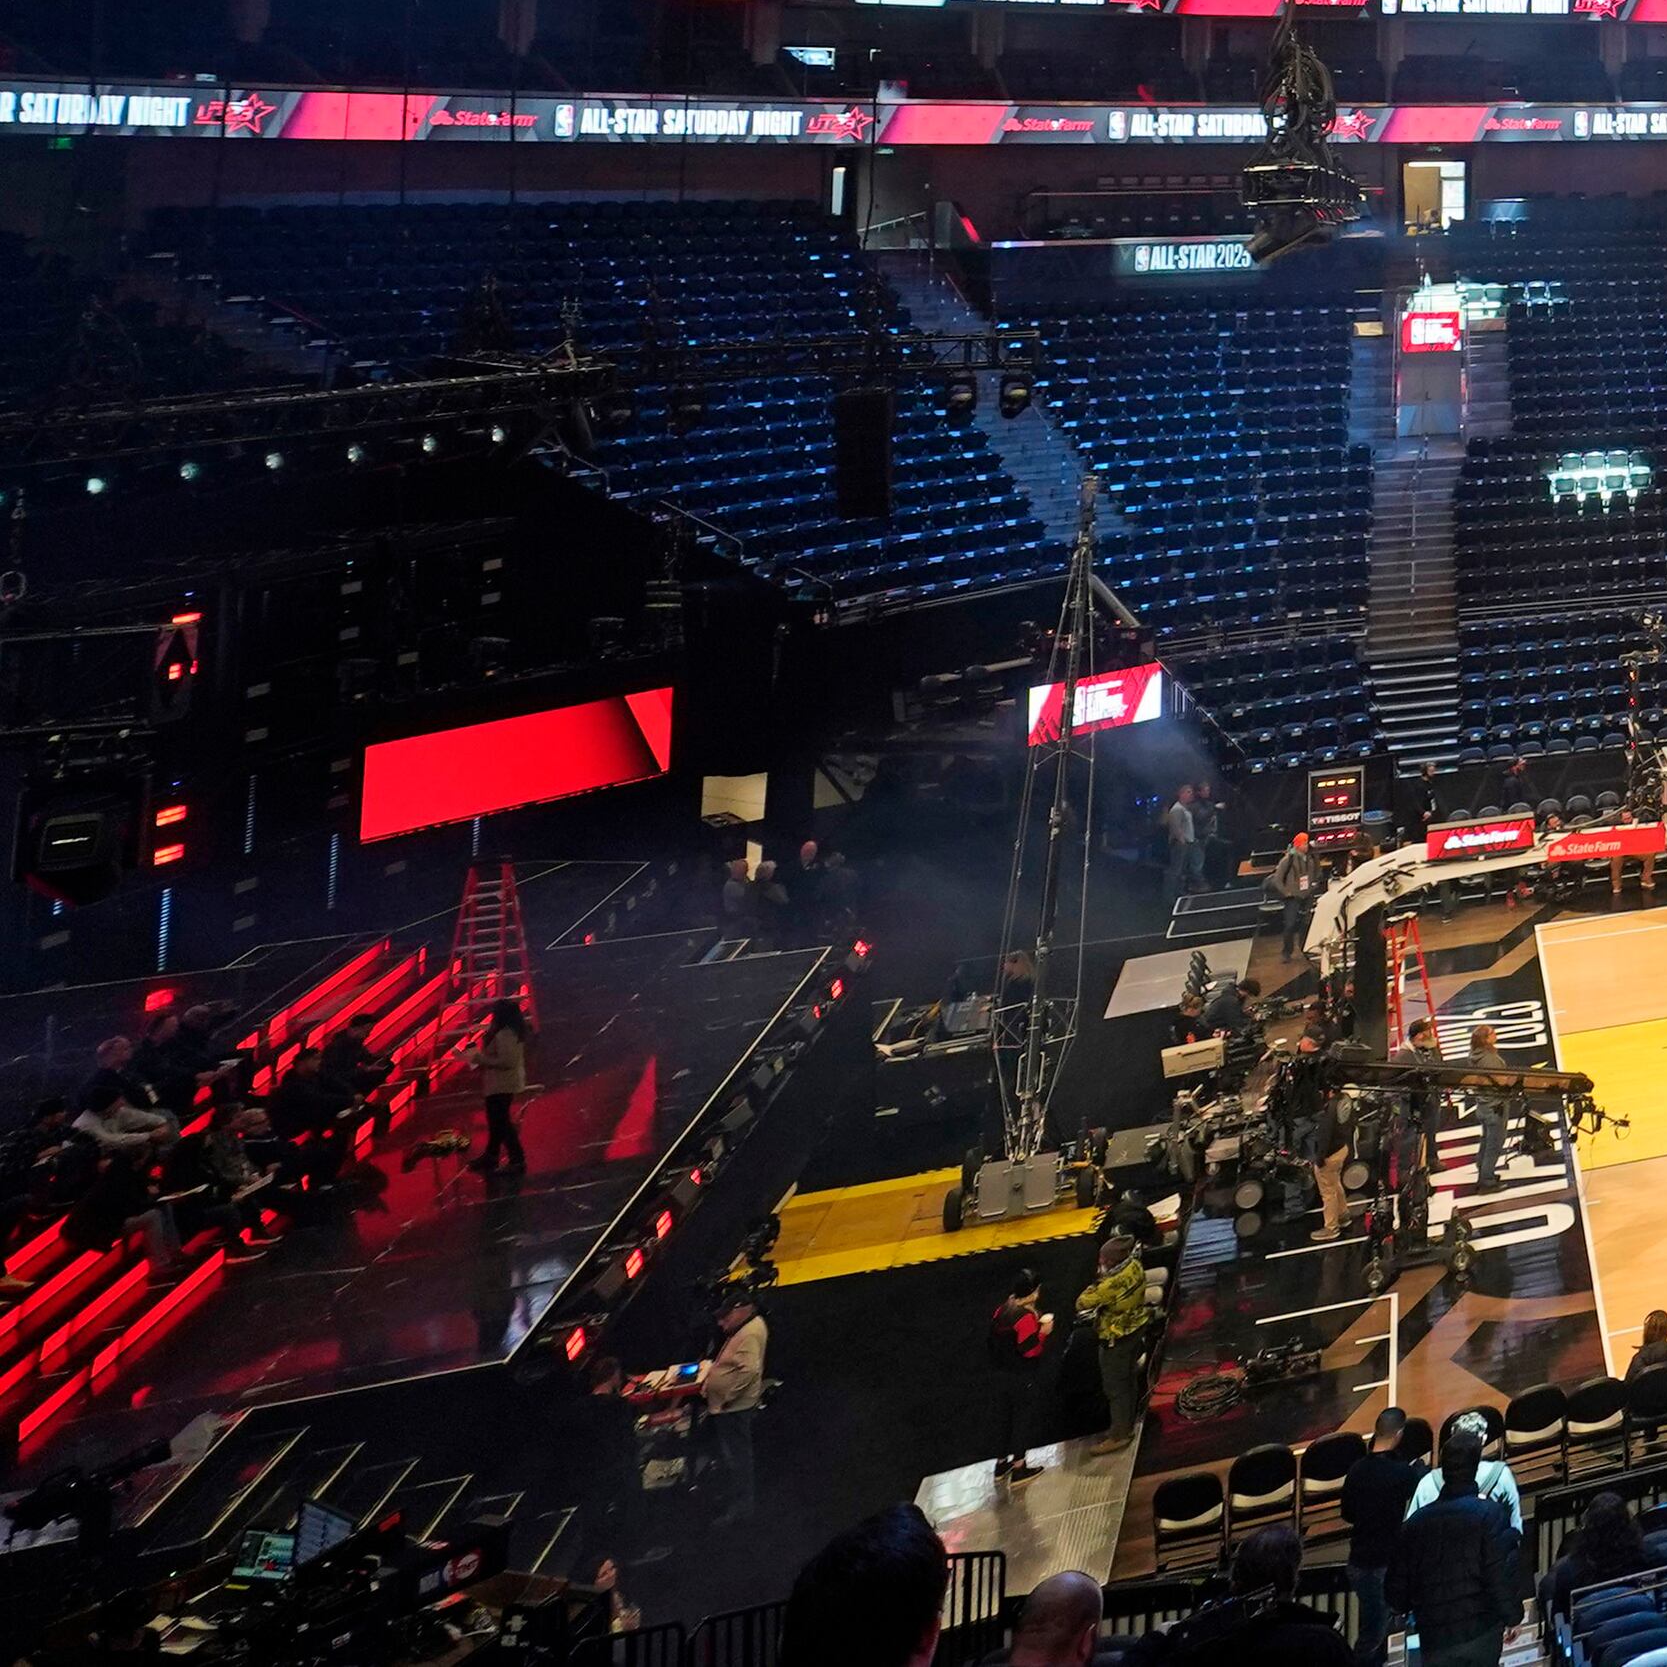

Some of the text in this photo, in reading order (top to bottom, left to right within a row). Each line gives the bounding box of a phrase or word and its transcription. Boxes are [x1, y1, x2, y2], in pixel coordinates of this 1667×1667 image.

[19, 92, 126, 125] SATURDAY
[127, 95, 191, 127] NIGHT
[662, 108, 750, 136] SATURDAY
[751, 110, 804, 136] NIGHT
